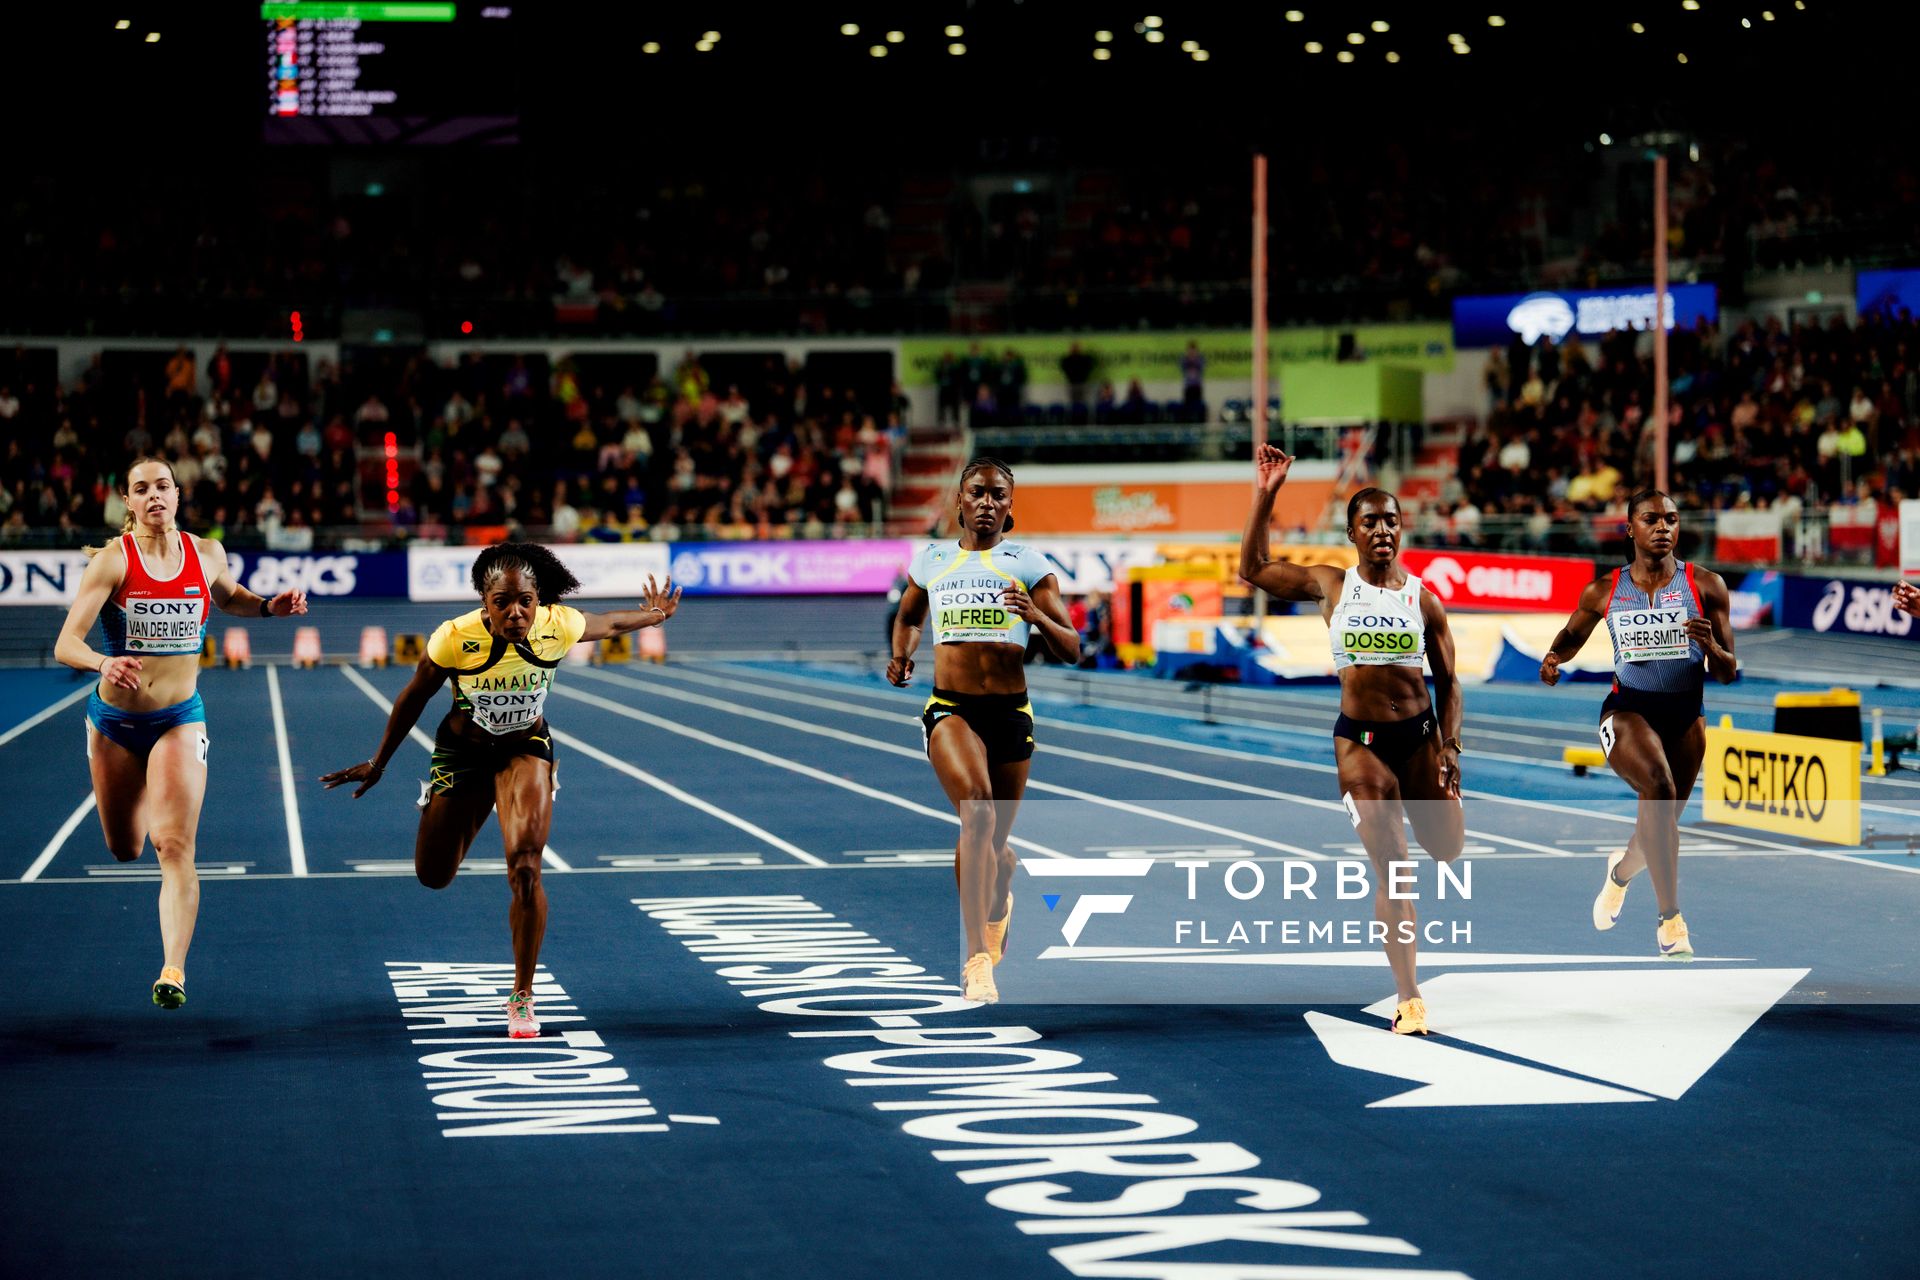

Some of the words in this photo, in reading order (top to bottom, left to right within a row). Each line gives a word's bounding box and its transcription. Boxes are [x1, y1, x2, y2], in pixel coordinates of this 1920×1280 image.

[248, 556, 358, 595] asics
[700, 552, 790, 586] TDK
[935, 580, 965, 592] SAINT
[1467, 566, 1552, 601] ORLEN
[133, 602, 197, 615] SONY
[942, 592, 1002, 606] SONY
[941, 609, 1005, 627] ALFRED
[1347, 615, 1410, 628] SONY
[1619, 611, 1680, 626] SONY
[129, 620, 149, 637] VAN
[150, 621, 168, 637] DER
[170, 620, 198, 637] WEKEN
[1619, 628, 1687, 648] ASHER-SMITH
[1344, 632, 1413, 649] DOSSO
[471, 670, 549, 691] JAMAICA
[478, 693, 541, 705] SONY
[479, 705, 539, 724] SMITH
[1602, 726, 1611, 748] 3
[1723, 746, 1828, 823] SEIKO
[384, 961, 587, 1030] ARENA
[411, 1030, 721, 1138] TORUŃ
